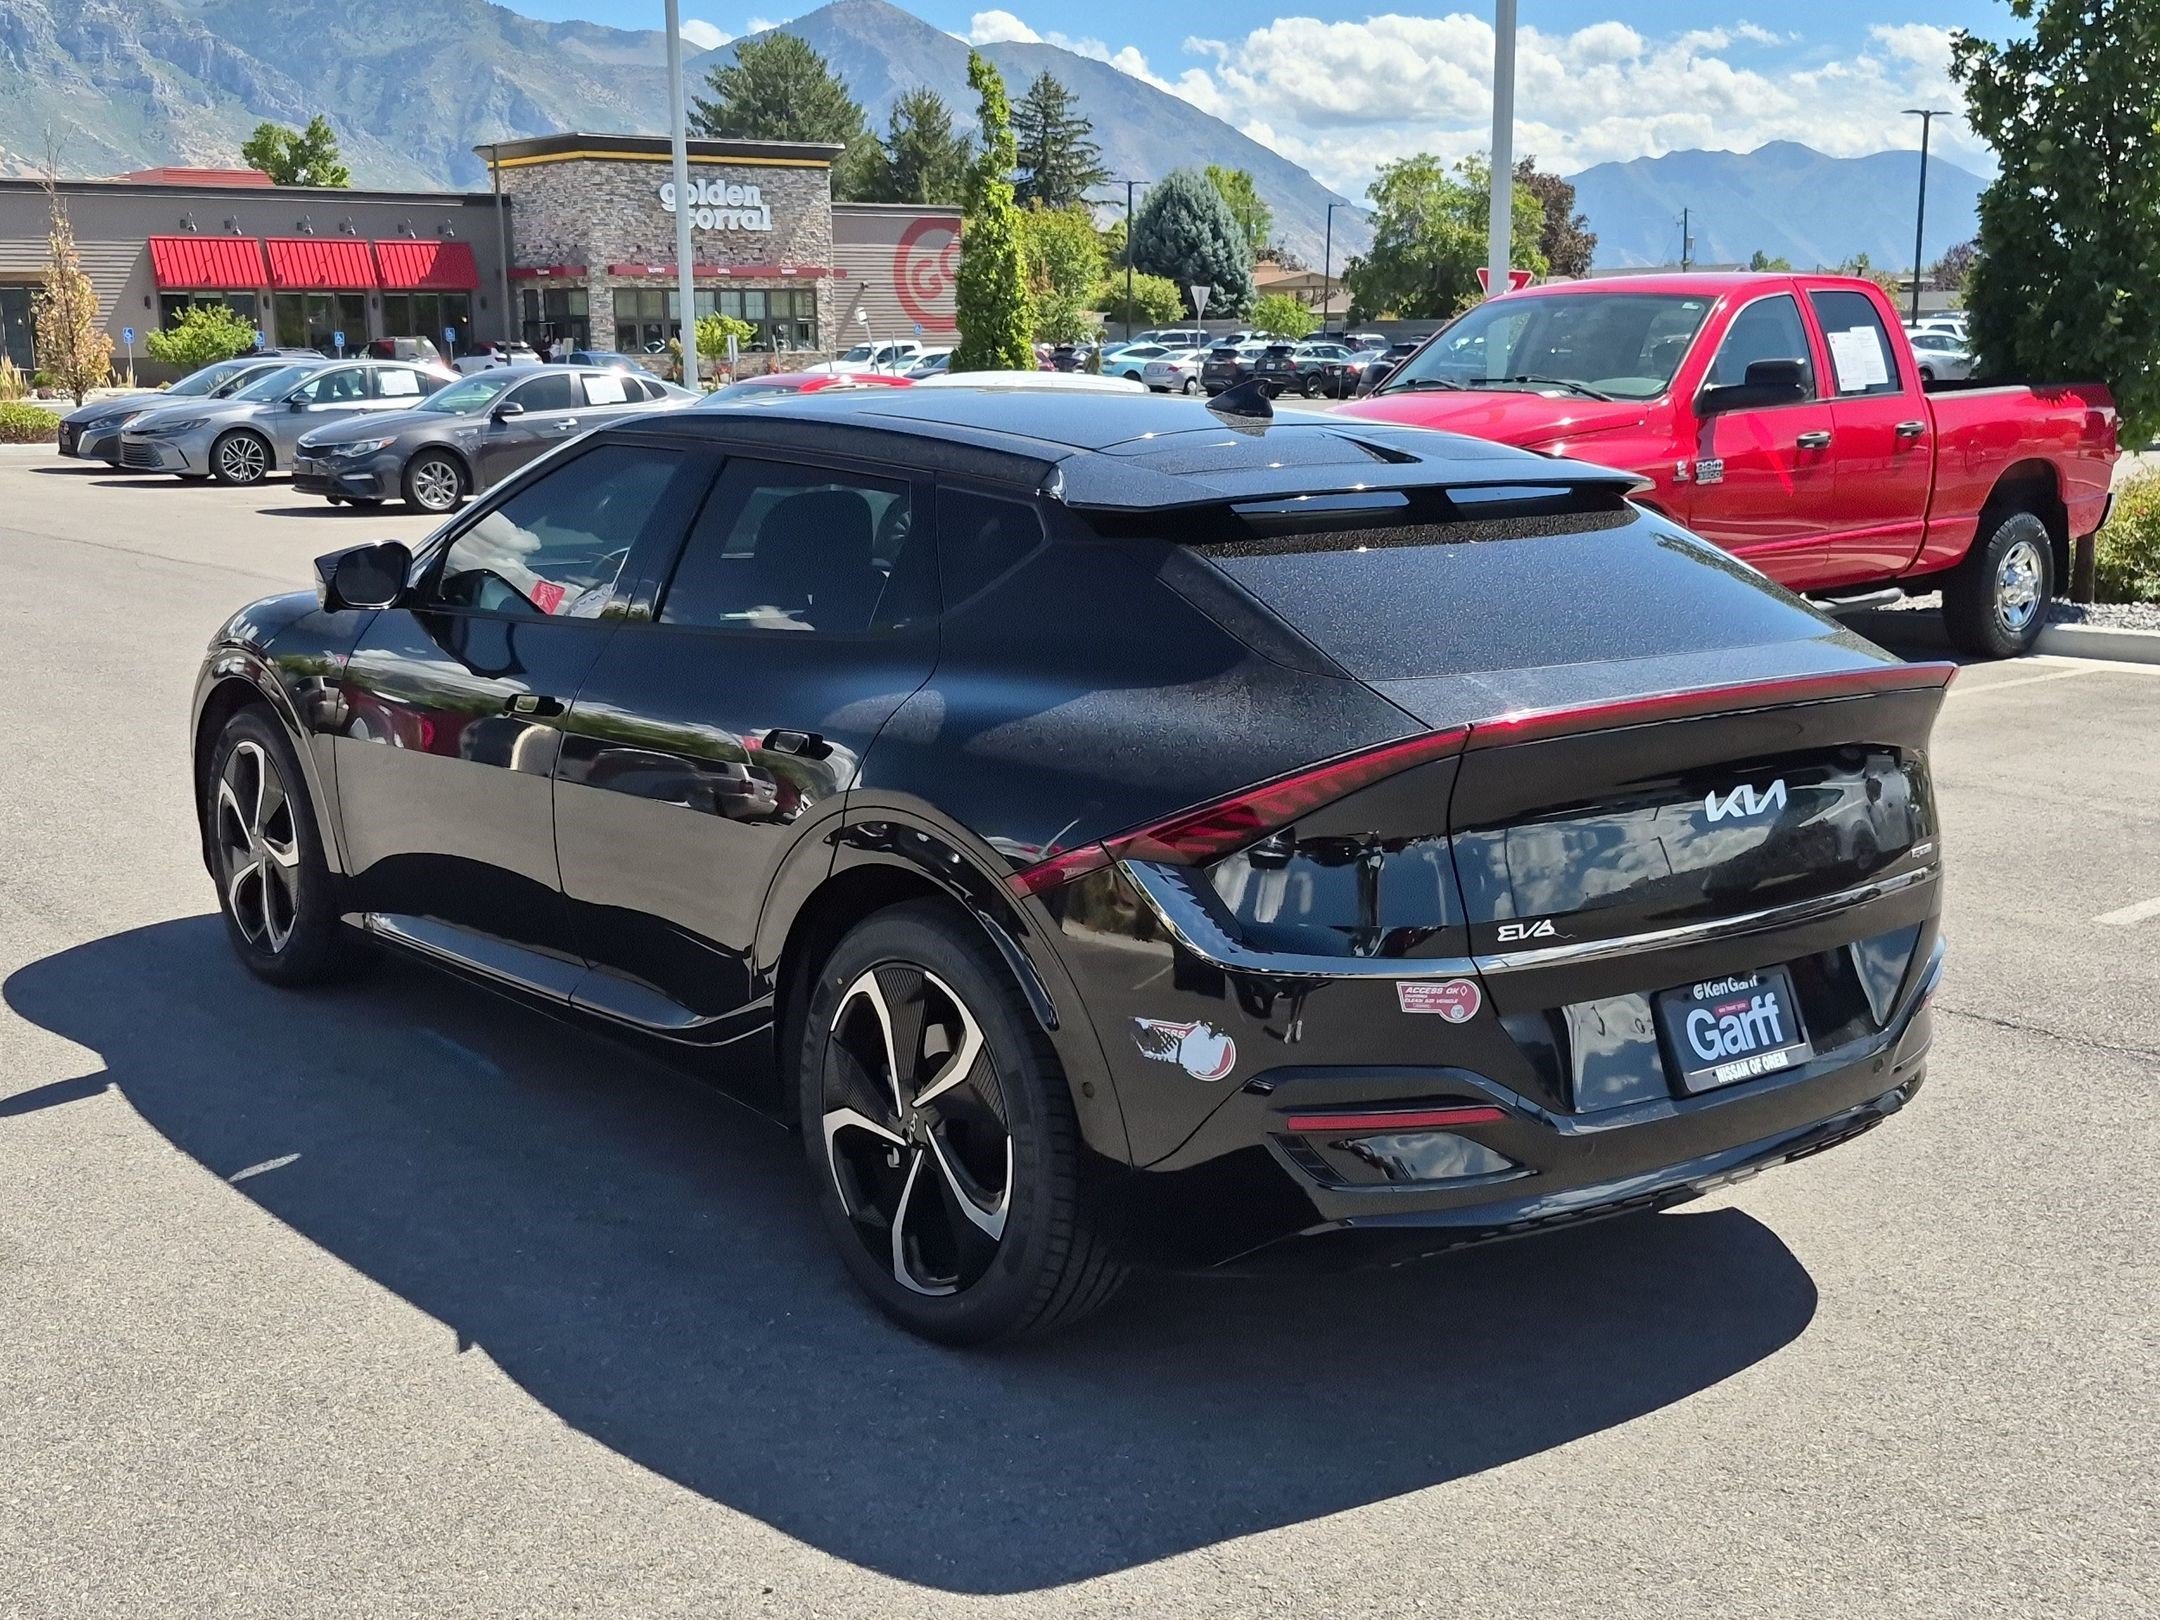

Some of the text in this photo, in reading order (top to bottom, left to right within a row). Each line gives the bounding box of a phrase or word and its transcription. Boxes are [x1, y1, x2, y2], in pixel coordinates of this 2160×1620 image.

[660, 179, 762, 212] golden
[1705, 779, 1787, 822] KIA
[1686, 992, 1783, 1061] Garff
[1715, 1051, 1789, 1083] NISSAN OF OREM
